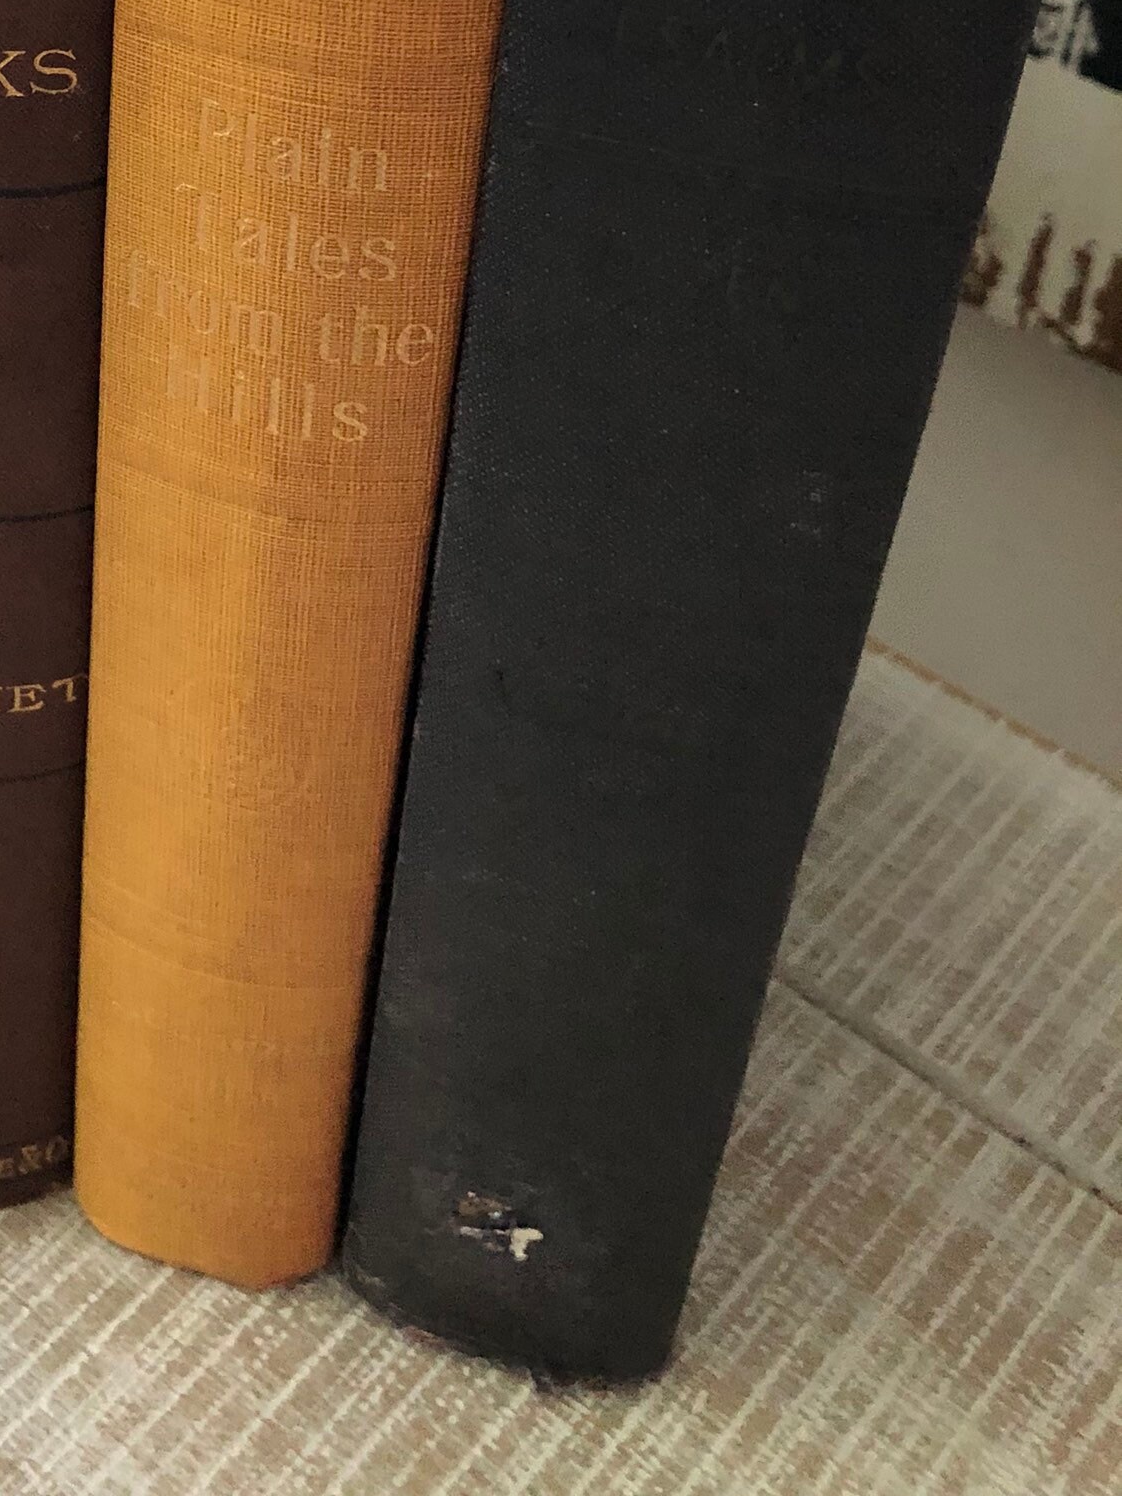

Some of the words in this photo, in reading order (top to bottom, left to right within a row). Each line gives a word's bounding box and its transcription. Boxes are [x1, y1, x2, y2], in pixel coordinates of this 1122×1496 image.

[197, 98, 390, 194] Plain
[176, 181, 396, 283] Tales
[318, 308, 435, 367] the
